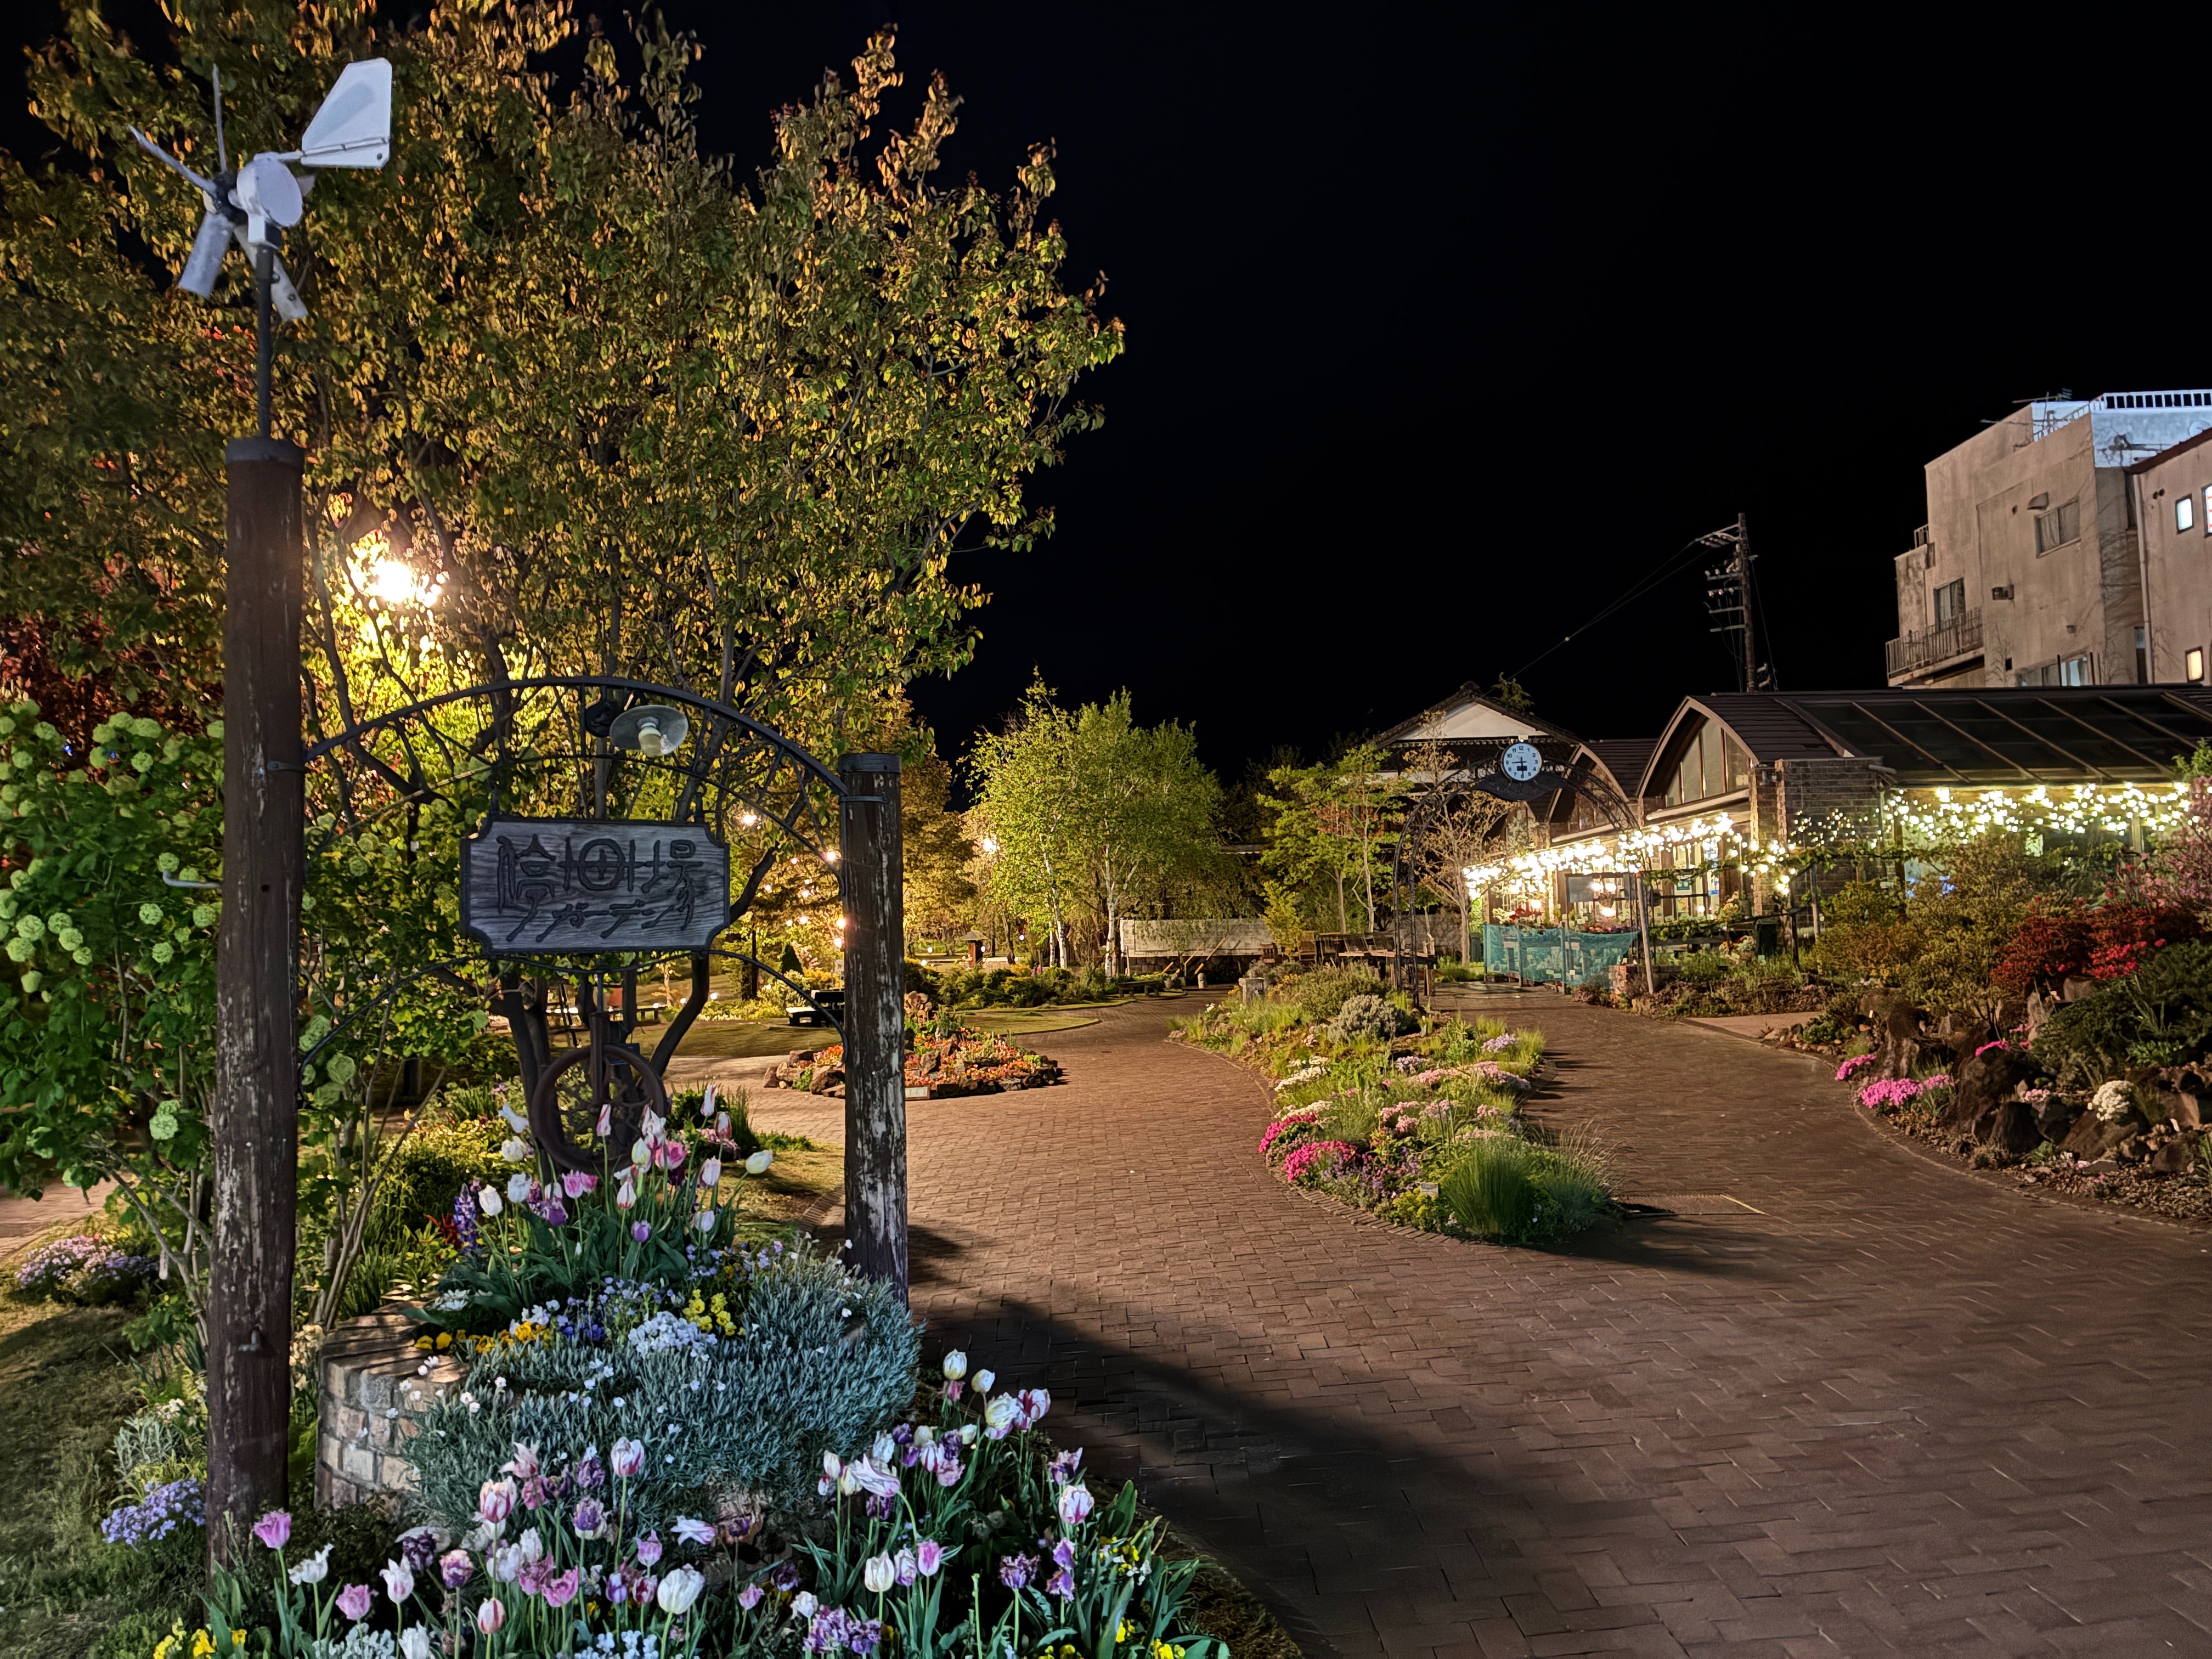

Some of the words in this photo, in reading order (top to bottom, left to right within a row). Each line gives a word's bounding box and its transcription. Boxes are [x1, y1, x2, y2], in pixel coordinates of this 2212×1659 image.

[496, 833, 704, 942] 停車場
[535, 899, 679, 943] ガーデン
